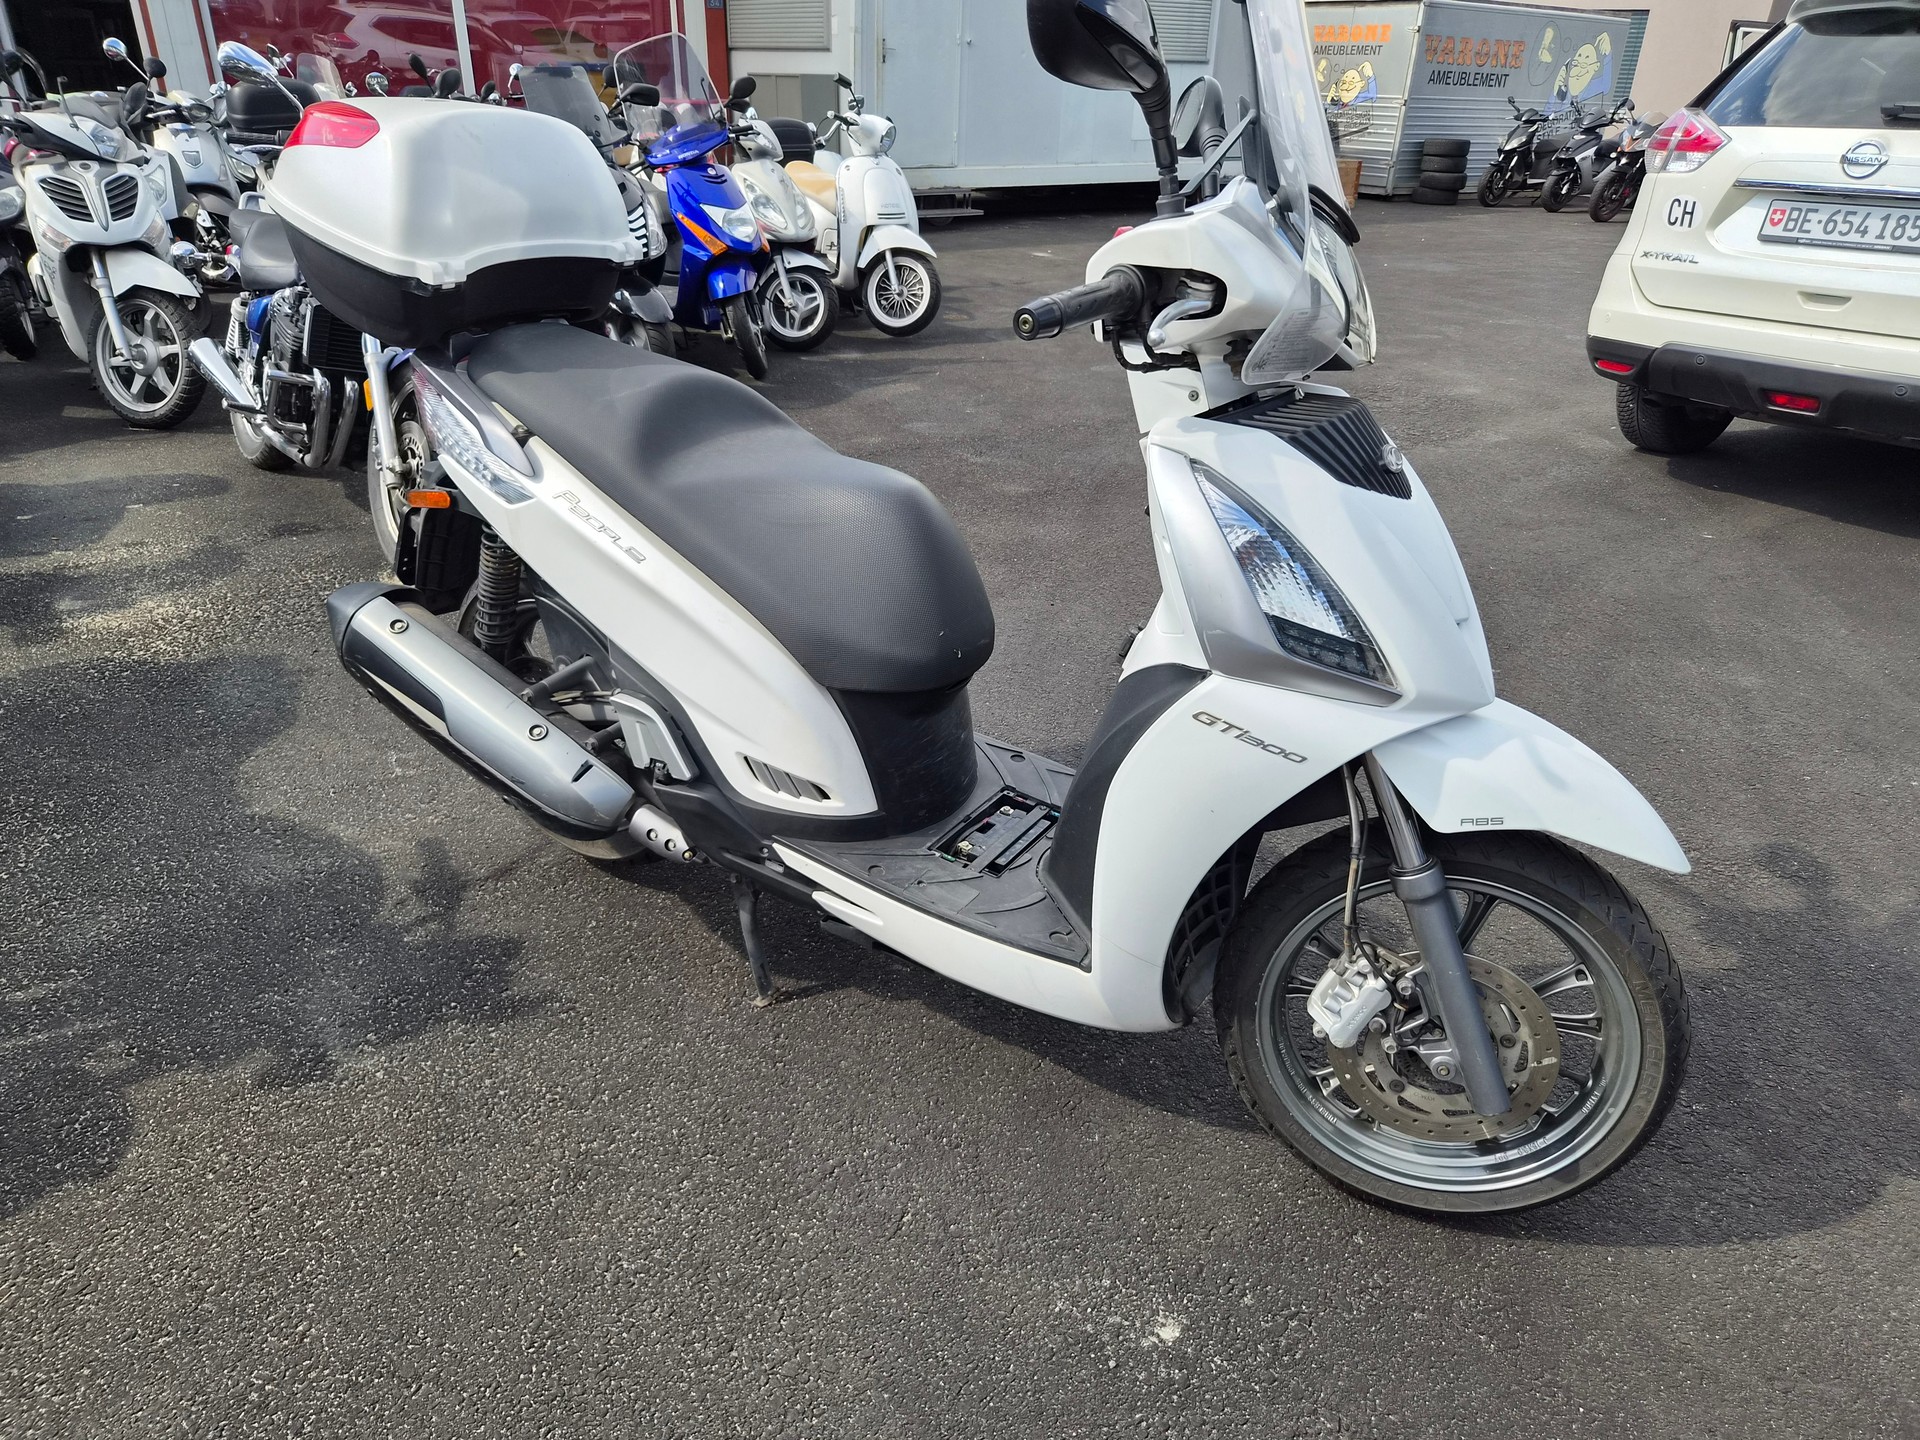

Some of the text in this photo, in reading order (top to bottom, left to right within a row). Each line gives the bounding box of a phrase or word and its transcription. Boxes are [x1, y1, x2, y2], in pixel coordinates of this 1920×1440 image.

[1313, 24, 1393, 43] VARONE
[1313, 45, 1383, 56] AMEUBLEMENT
[1424, 34, 1525, 69] VARONE
[1427, 70, 1510, 88] AMEUBLEMENT
[677, 149, 700, 160] HONDA
[1844, 155, 1883, 163] NISSAN
[1667, 198, 1697, 228] CH
[1640, 250, 1700, 264] X-TRAIL
[1460, 817, 1504, 826] ABS
[1632, 979, 1664, 1099] METZELER
